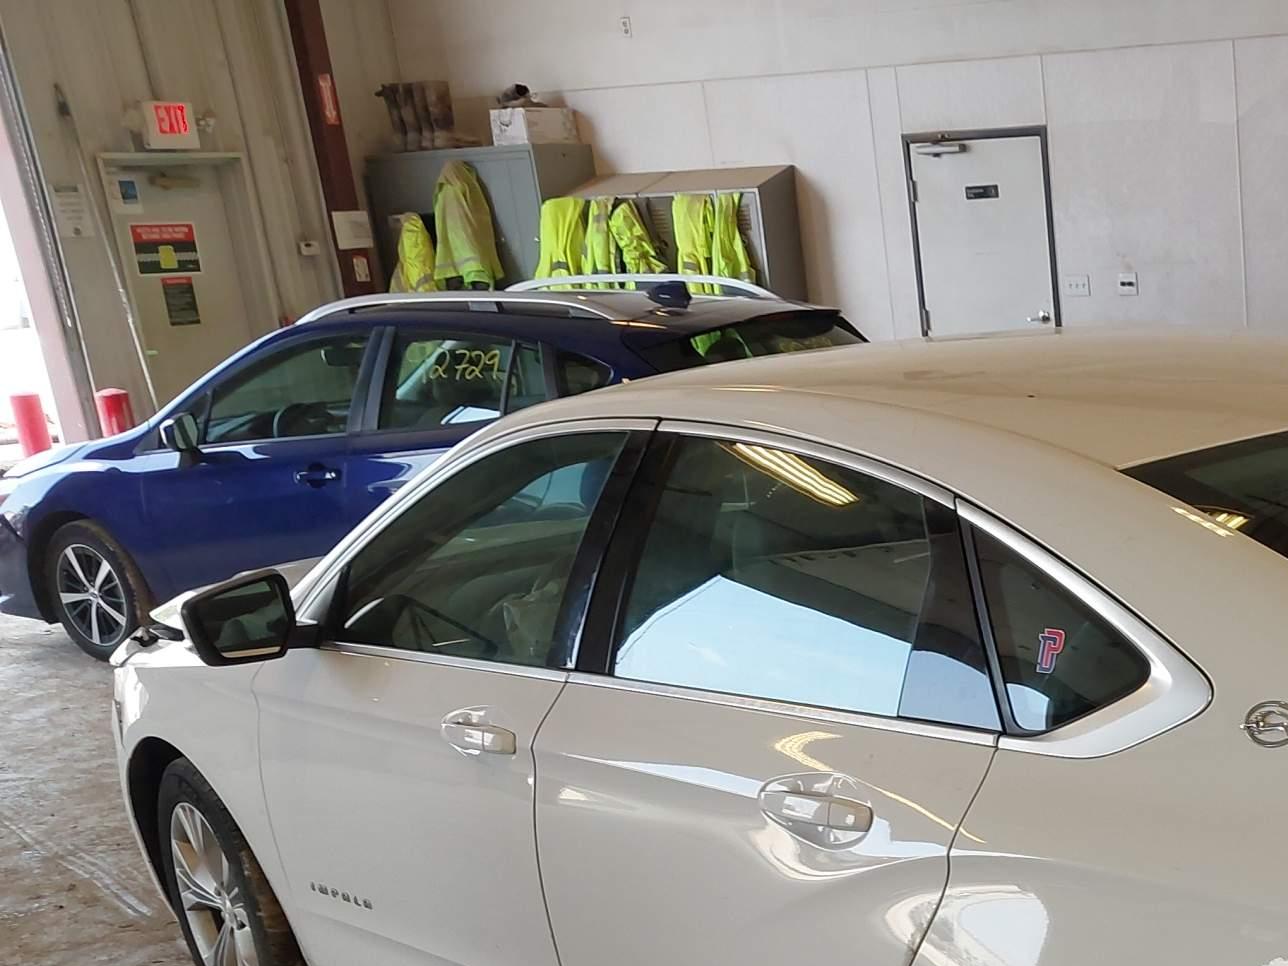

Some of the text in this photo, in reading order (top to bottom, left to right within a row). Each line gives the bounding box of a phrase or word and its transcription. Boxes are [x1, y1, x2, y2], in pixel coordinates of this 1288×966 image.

[153, 105, 188, 135] EXIT
[420, 348, 501, 384] 2729
[310, 881, 373, 910] IMPALA
